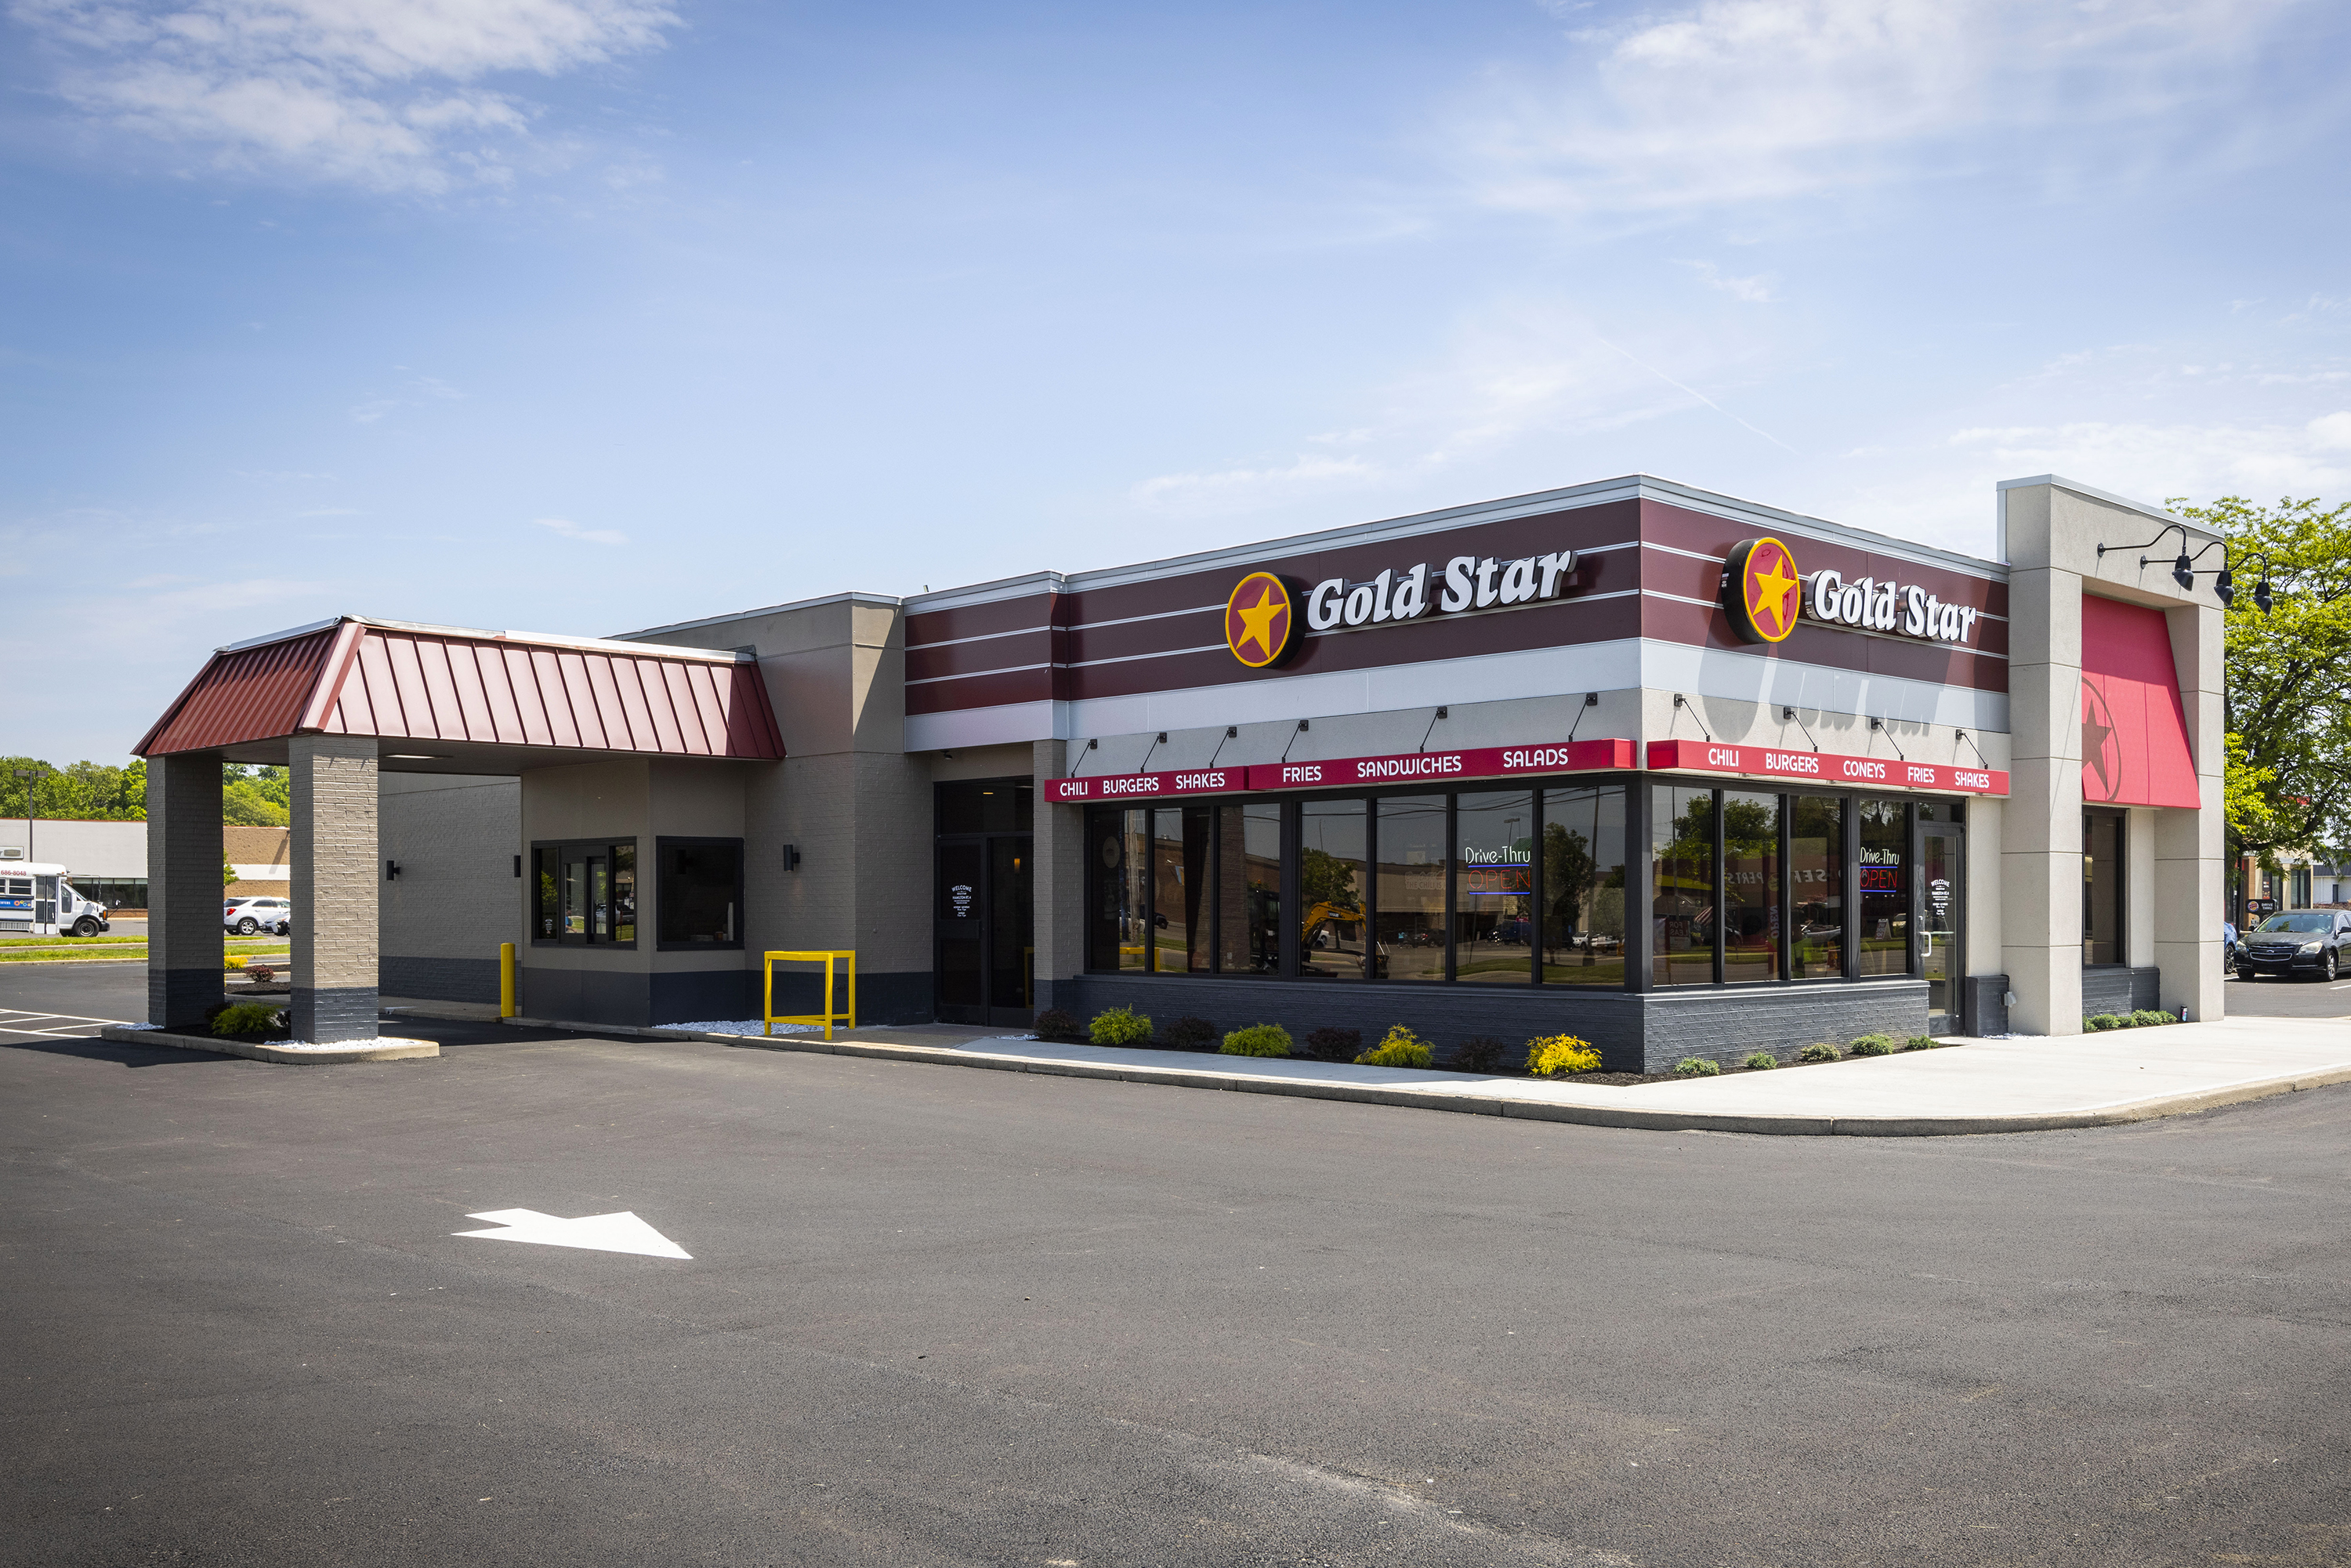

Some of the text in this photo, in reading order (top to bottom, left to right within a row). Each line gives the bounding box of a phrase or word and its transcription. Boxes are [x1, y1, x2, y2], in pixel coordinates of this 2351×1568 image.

[1307, 550, 1576, 630] Gold Star
[1810, 569, 1976, 643] Gold Star
[1283, 748, 1569, 783] FRIES SANDWICHES SALADS
[1708, 748, 1990, 788] CHILI BURGERS CONEYS FRIES SHAKES
[1060, 772, 1225, 796] CHILI BURGERS SHAKES
[1465, 846, 1531, 864] Drive-Thru
[1860, 846, 1900, 864] Drive-Thru
[1468, 870, 1531, 889] OPEN
[1860, 869, 1897, 888] OPEN
[1931, 878, 1950, 887] WELCOME
